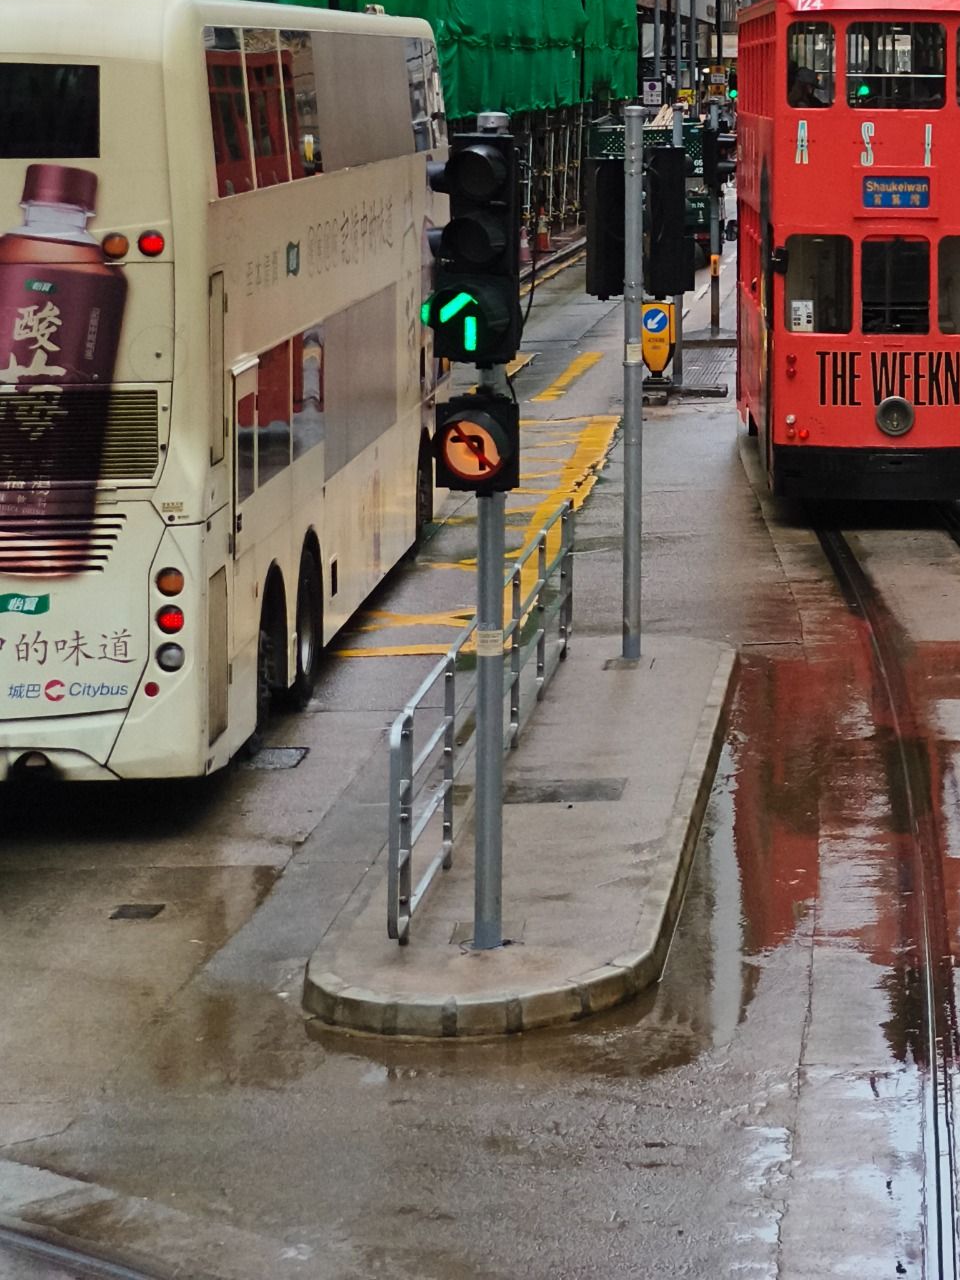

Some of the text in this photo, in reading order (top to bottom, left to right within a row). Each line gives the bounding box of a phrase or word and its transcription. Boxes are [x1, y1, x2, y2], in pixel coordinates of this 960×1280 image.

[866, 181, 929, 192] Shaukeiwan
[816, 351, 862, 406] THE
[0, 628, 137, 666] 的味道
[8, 683, 41, 699] 城巴
[69, 682, 128, 698] Citybus
